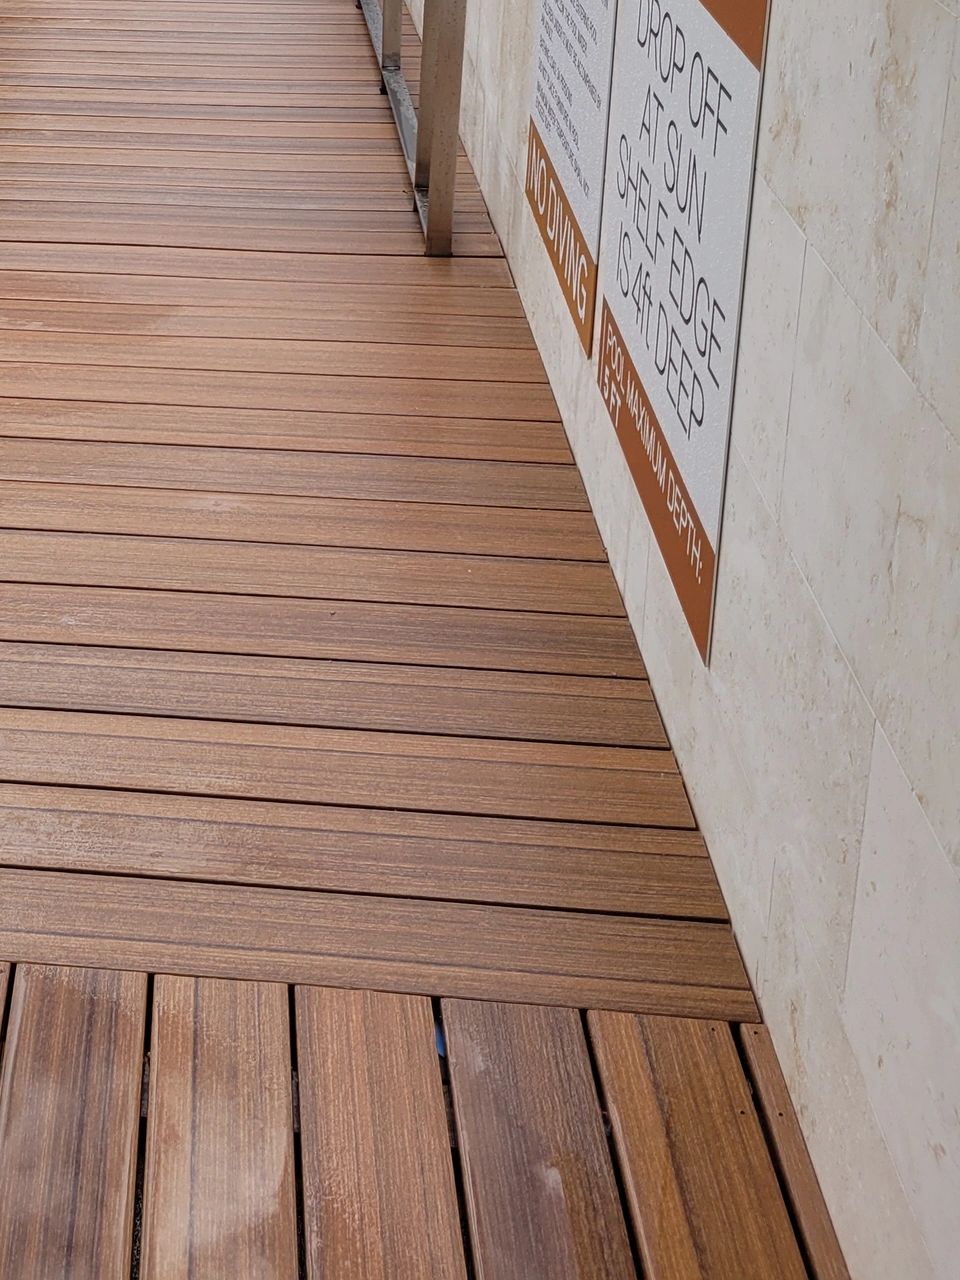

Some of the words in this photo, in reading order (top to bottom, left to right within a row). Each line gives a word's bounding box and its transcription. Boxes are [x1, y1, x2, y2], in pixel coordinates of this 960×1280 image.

[638, 83, 665, 165] AT
[663, 119, 707, 245] SUN
[688, 51, 733, 158] OFF
[529, 137, 547, 216] NO
[546, 177, 588, 325] DIVING
[616, 133, 669, 265] SHELF
[668, 226, 726, 391] EDGE
[603, 365, 610, 400] 5
[609, 380, 622, 428] FT
[616, 221, 632, 299] IS
[631, 261, 653, 351] 4ft
[654, 300, 705, 441] DEEP
[606, 322, 625, 395] POOL
[625, 370, 667, 493] MAXIMUM
[666, 469, 703, 585] DEPTH:
